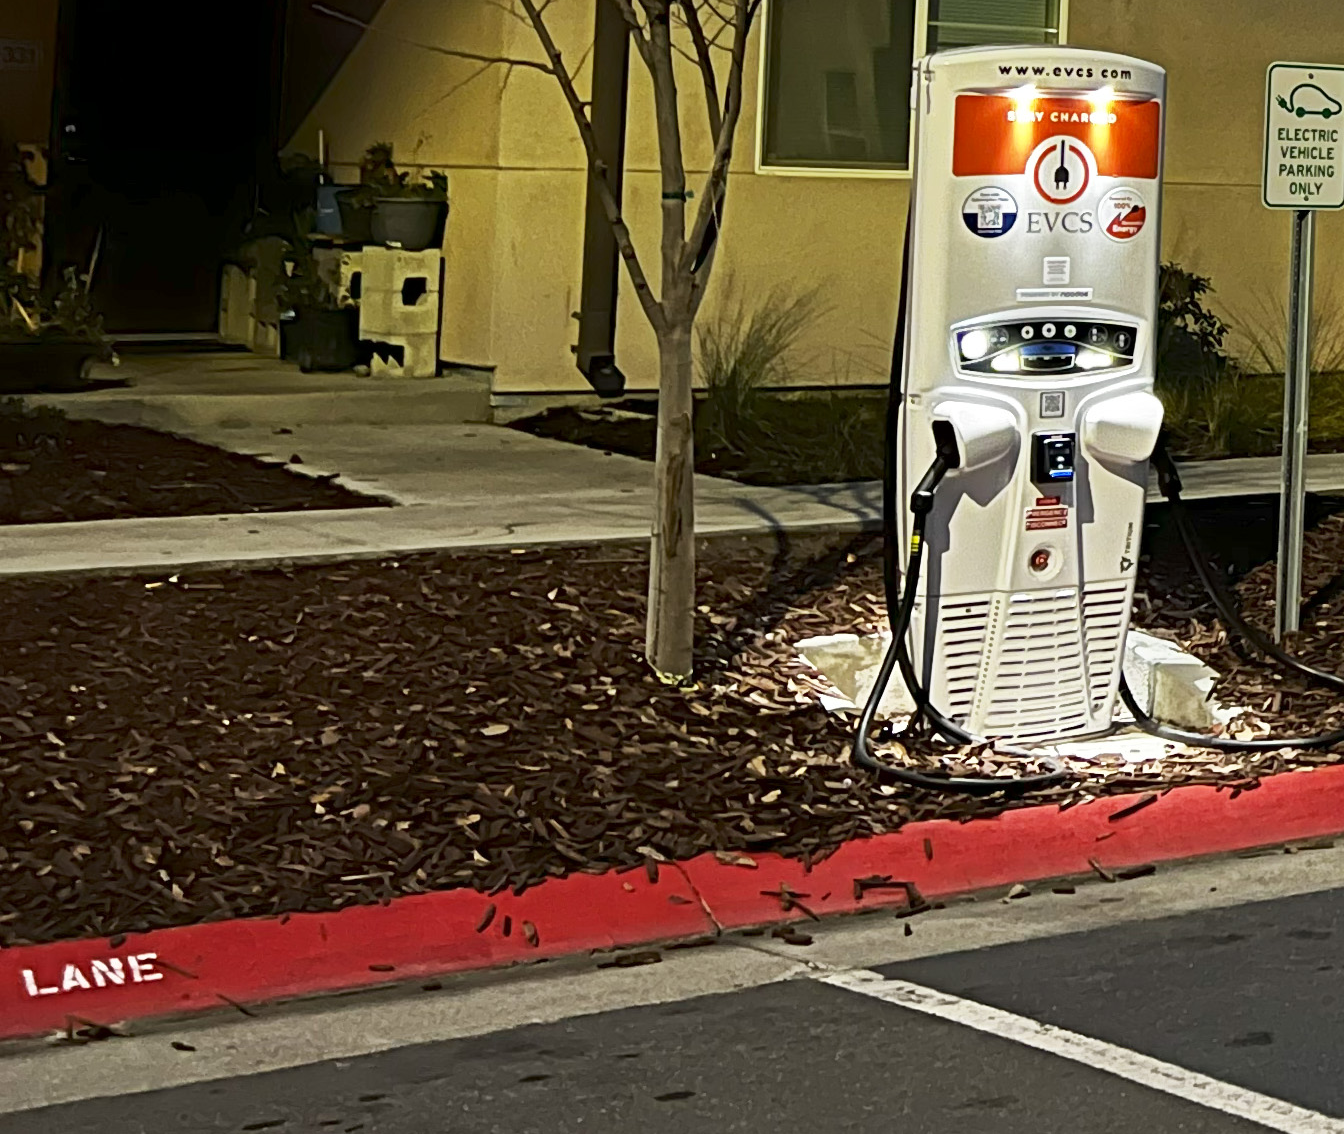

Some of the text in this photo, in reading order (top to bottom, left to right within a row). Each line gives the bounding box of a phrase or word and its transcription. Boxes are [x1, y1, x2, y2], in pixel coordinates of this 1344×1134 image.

[1007, 111, 1118, 124] SAY CHARD
[1277, 128, 1338, 142] ELECTRIC
[1280, 145, 1335, 160] VEHICLE
[1278, 164, 1335, 178] PARKING
[1289, 182, 1323, 195] ONLY
[1026, 212, 1093, 234] EVCS
[22, 952, 164, 997] LANE
